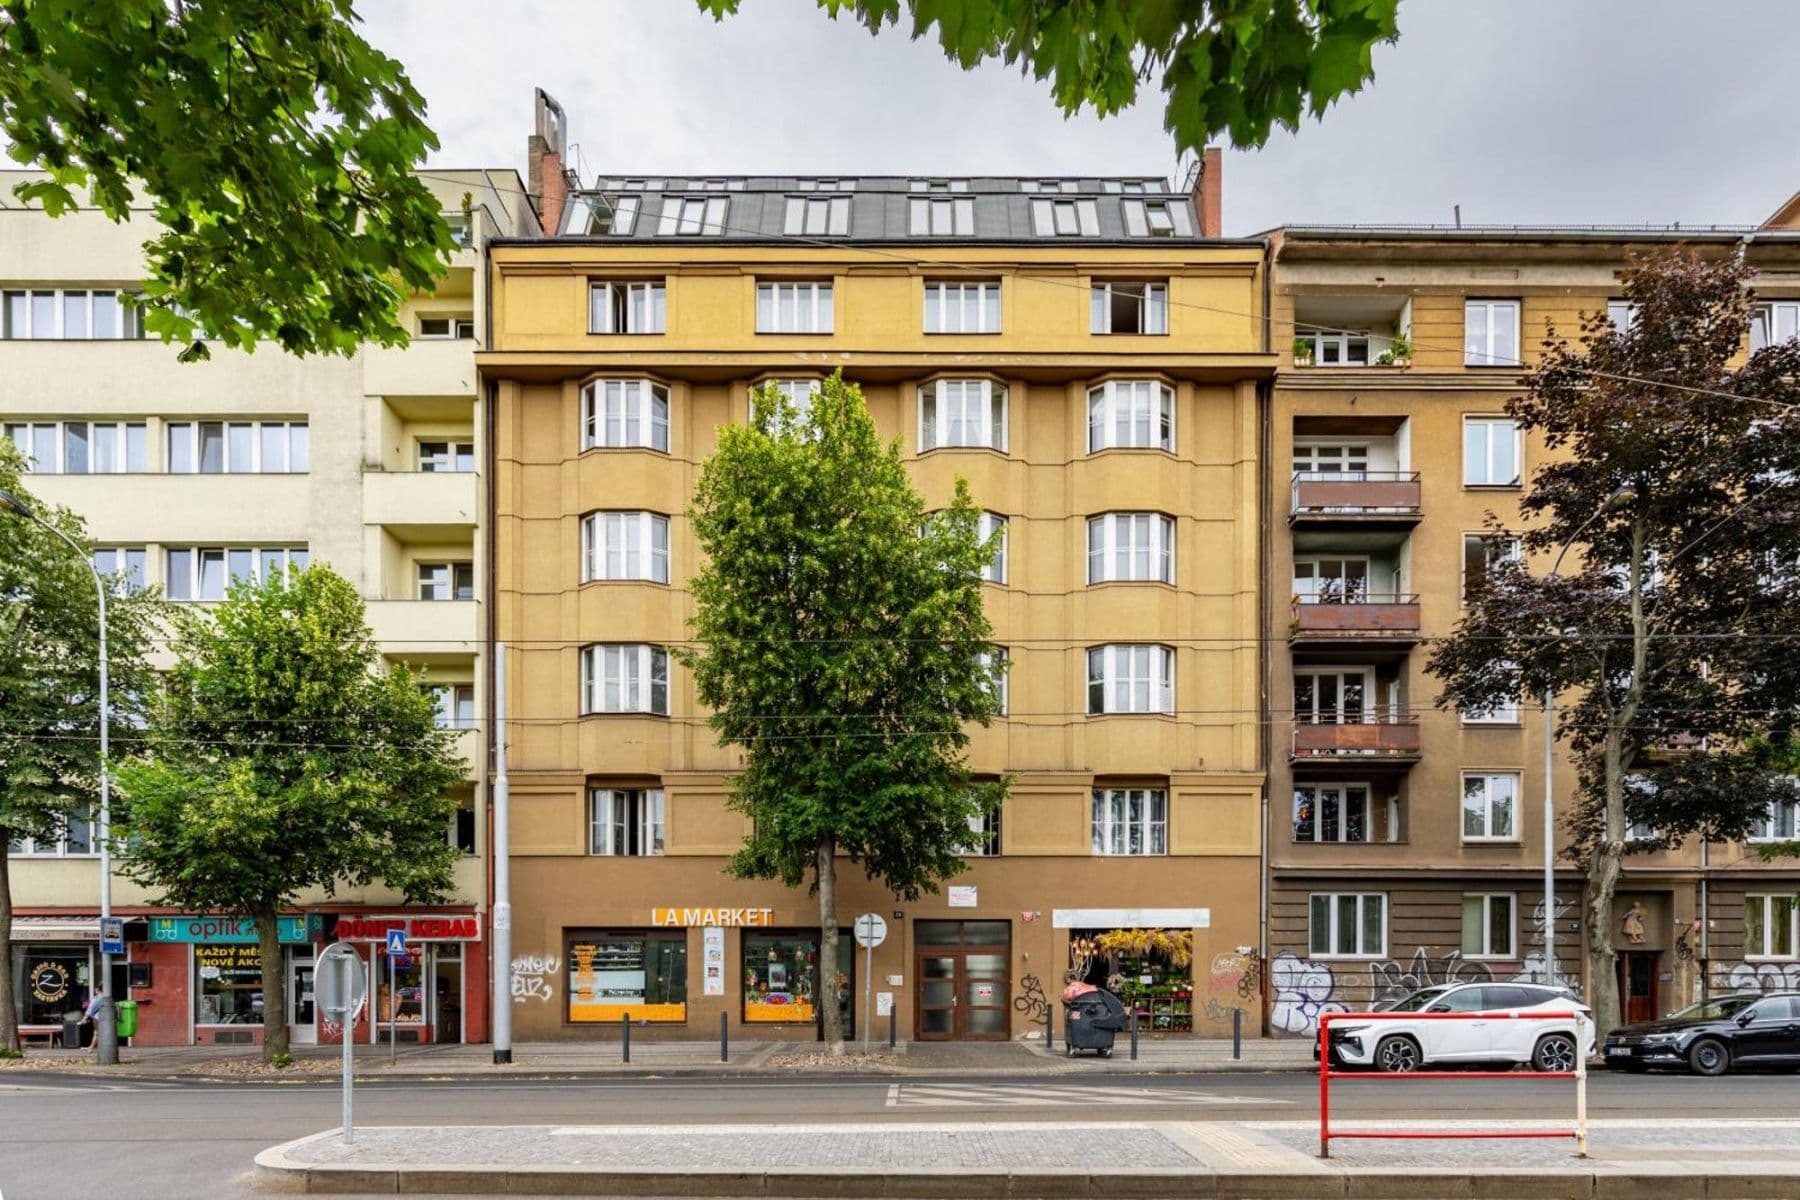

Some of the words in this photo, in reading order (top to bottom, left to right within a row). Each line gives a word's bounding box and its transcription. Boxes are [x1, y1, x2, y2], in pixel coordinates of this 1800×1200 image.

[652, 908, 680, 926] LA
[683, 908, 772, 926] MARKET
[189, 918, 241, 940] optik
[410, 918, 478, 938] KEBAB
[196, 945, 235, 957] KAŽDÝ
